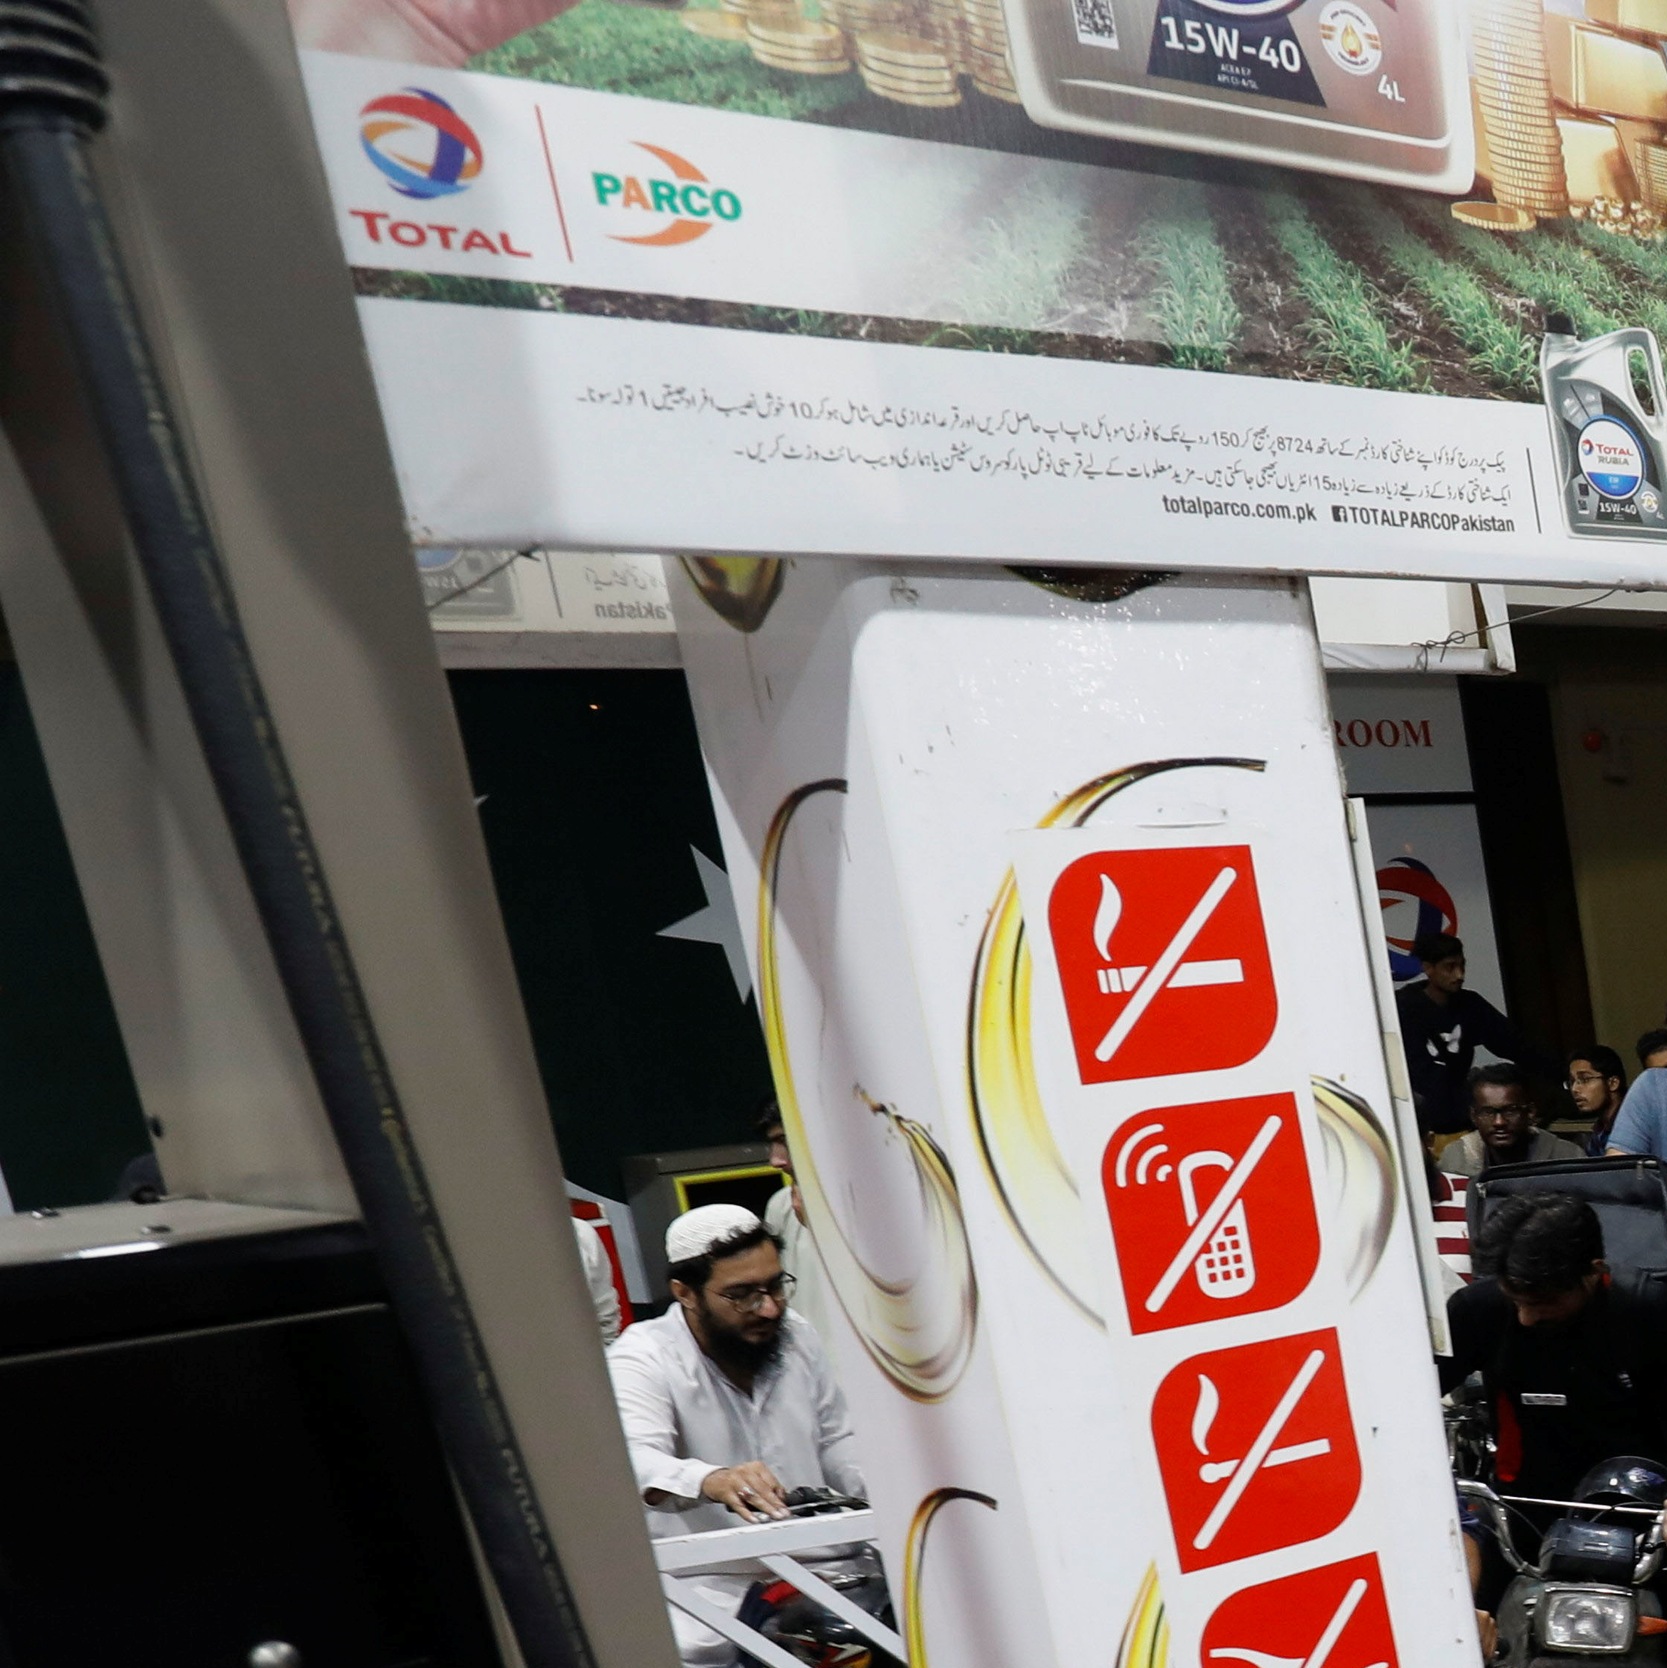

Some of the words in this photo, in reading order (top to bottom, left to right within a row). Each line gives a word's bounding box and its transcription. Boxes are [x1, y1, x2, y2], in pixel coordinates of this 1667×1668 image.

[1161, 15, 1301, 73] 15W-40
[1378, 74, 1406, 102] 4L
[591, 171, 742, 223] PARCO
[349, 209, 534, 260] TOTAL
[640, 390, 648, 406] 1
[790, 402, 812, 419] 10
[1212, 431, 1240, 448] 150
[1277, 436, 1313, 453] 8724
[1595, 444, 1634, 457] TOTAL
[1597, 456, 1630, 466] RUBIA
[1314, 474, 1332, 491] 15
[1162, 495, 1317, 524] totalparco.com.pk
[1349, 506, 1515, 532] TOTALPARCOPakistan
[1599, 502, 1637, 515] 15W-40
[279, 801, 337, 937] FUTURA
[495, 1446, 554, 1561] FUTURA
